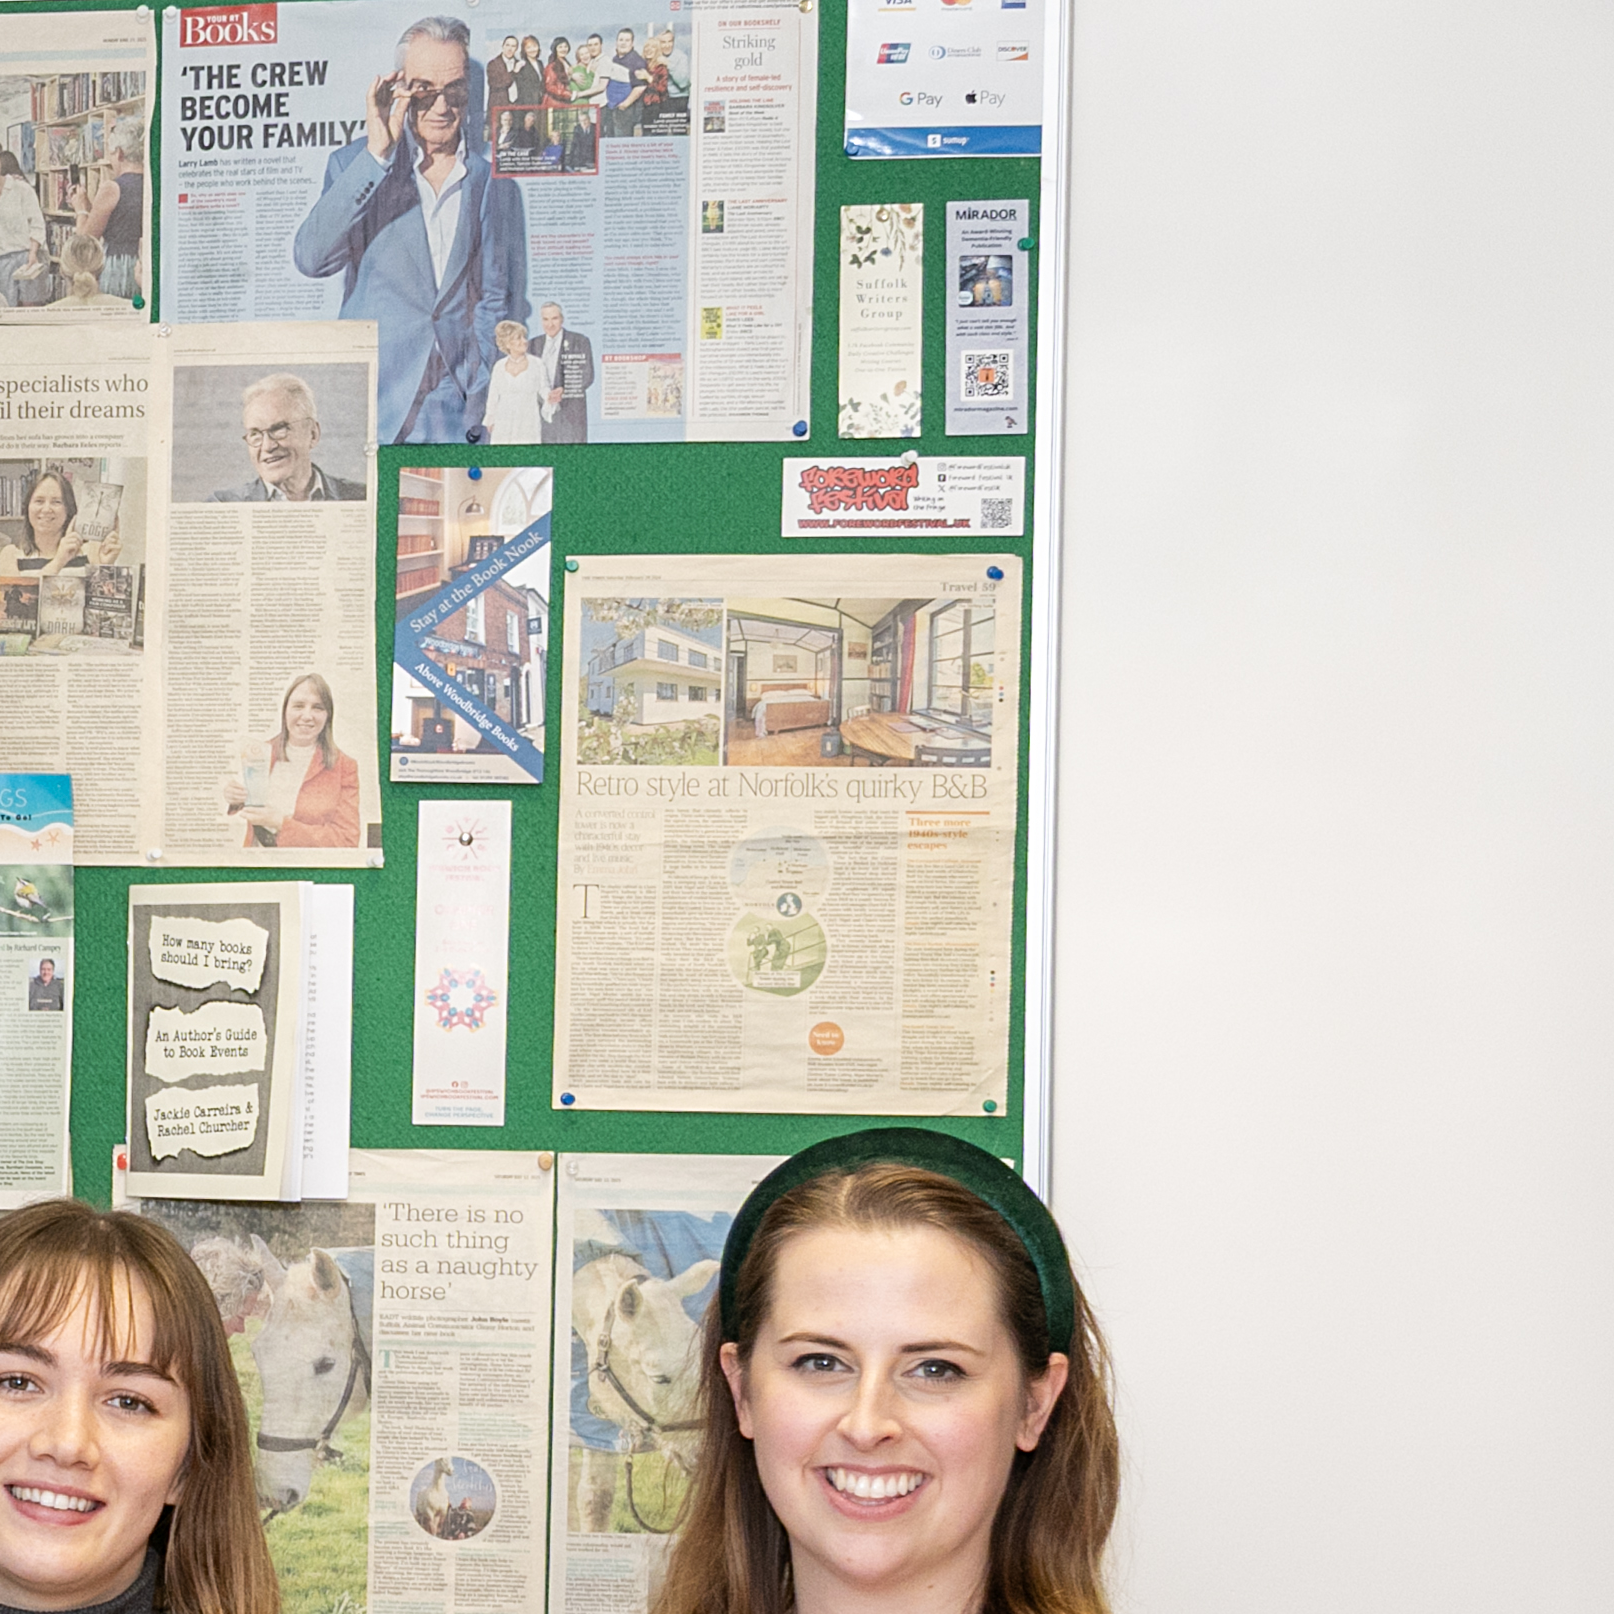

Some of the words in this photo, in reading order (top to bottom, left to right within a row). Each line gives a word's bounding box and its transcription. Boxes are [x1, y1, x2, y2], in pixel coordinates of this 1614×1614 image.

[230, 14, 240, 22] AT
[184, 12, 276, 45] Books
[722, 34, 776, 51] Striking
[734, 52, 762, 70] gold
[181, 64, 241, 90] 'THE
[251, 60, 328, 88] CREW
[181, 92, 289, 121] BECOME
[917, 92, 942, 108] Pay
[980, 90, 1005, 108] Pay
[180, 125, 253, 152] YOUR
[263, 120, 366, 148] FAMILY'
[856, 278, 908, 289] Suffolk
[856, 294, 908, 304] Writers
[861, 309, 903, 320] Group
[105, 374, 149, 392] who
[18, 401, 64, 420] their
[69, 400, 146, 419] dreams
[410, 612, 439, 634] Stay
[438, 600, 451, 614] at
[450, 584, 473, 606] the
[470, 557, 506, 588] Book
[503, 530, 544, 562] Nook
[940, 582, 977, 592] Travel
[982, 582, 996, 592] 59
[414, 662, 442, 688] Above
[442, 683, 493, 731] Woodbridge
[490, 724, 520, 753] Books
[576, 771, 639, 798] Retro
[646, 771, 701, 802] style
[708, 776, 730, 798] at
[738, 771, 838, 798] Norfolk's
[845, 773, 924, 803] quirky
[931, 774, 988, 799] B&B
[162, 934, 182, 947] How
[187, 939, 215, 954] many
[220, 940, 252, 955] books
[161, 952, 198, 966] should
[203, 955, 208, 967] I
[214, 956, 252, 974] bring?
[155, 1030, 169, 1042] An
[173, 1028, 222, 1041] Author's
[225, 1029, 257, 1041] Guide
[163, 1046, 175, 1058] to
[179, 1045, 206, 1058] Book
[211, 1045, 248, 1057] Events
[154, 1106, 190, 1121] Jackie
[194, 1104, 241, 1119] Carreira
[246, 1102, 253, 1114] &
[157, 1124, 196, 1137] Rachel
[199, 1120, 250, 1135] Churcher
[383, 1202, 458, 1222] 'There
[466, 1205, 486, 1223] is
[494, 1209, 524, 1224] no
[381, 1229, 437, 1248] such
[446, 1230, 510, 1254] thing
[381, 1259, 408, 1274] as
[415, 1260, 429, 1274] a
[437, 1257, 538, 1281] naughty
[380, 1280, 452, 1300] horse'
